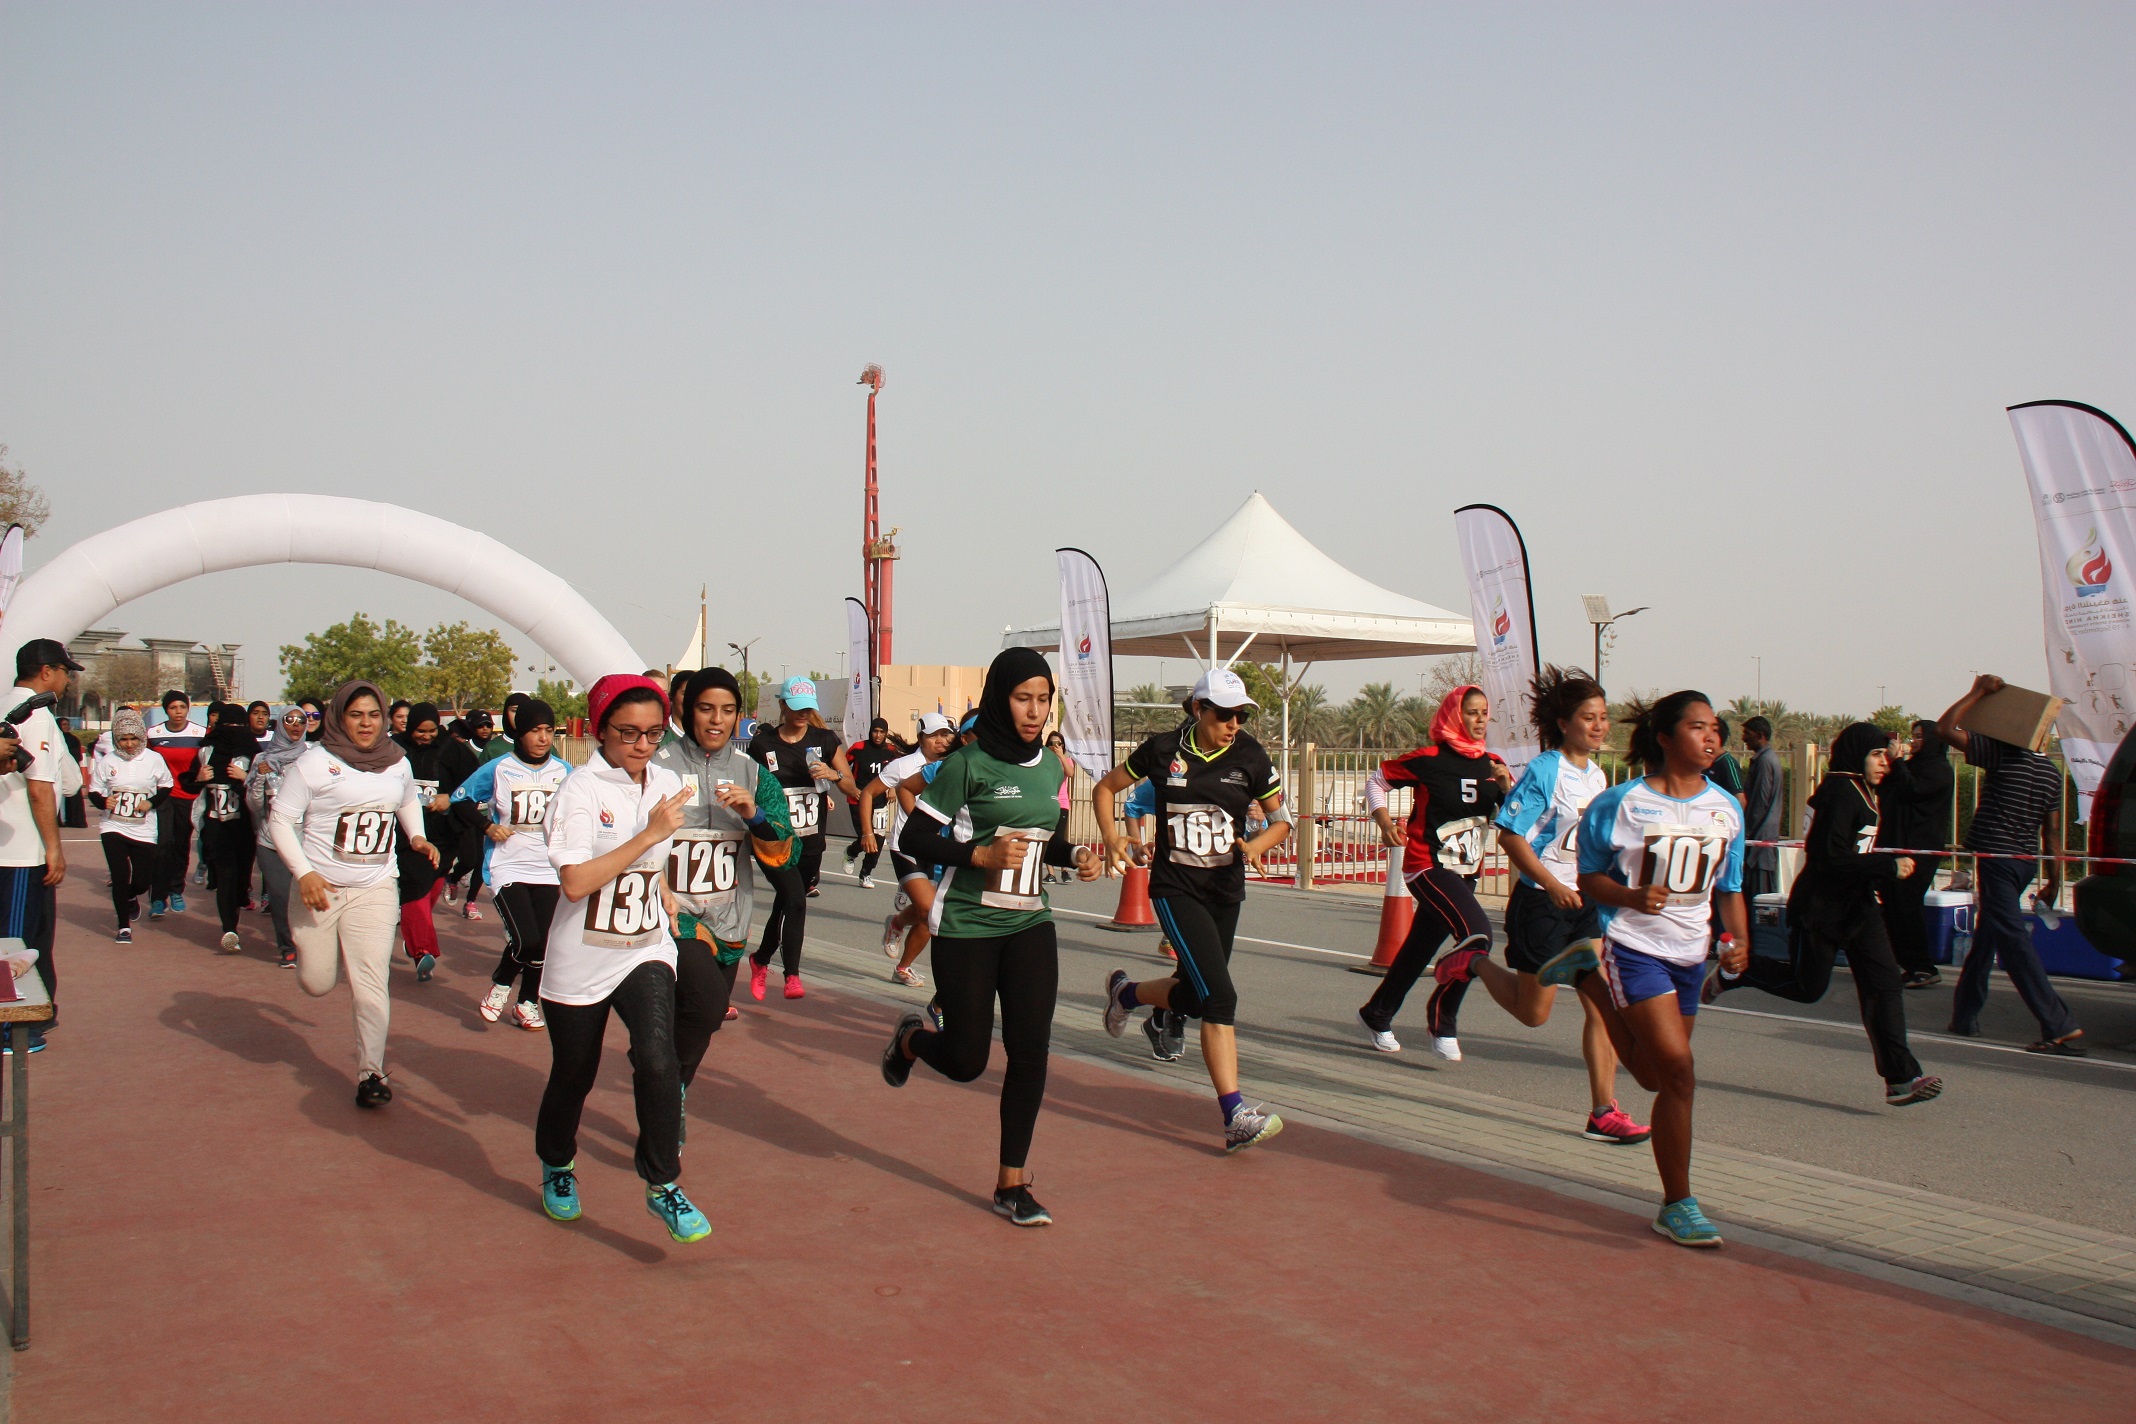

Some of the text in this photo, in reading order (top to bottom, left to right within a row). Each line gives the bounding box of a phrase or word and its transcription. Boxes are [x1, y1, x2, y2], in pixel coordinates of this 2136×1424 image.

[869, 762, 882, 774] 11
[788, 793, 820, 828] 53
[1461, 778, 1478, 804] 5
[342, 811, 394, 854] 137
[670, 840, 737, 893] 126
[1649, 836, 1723, 893] 101
